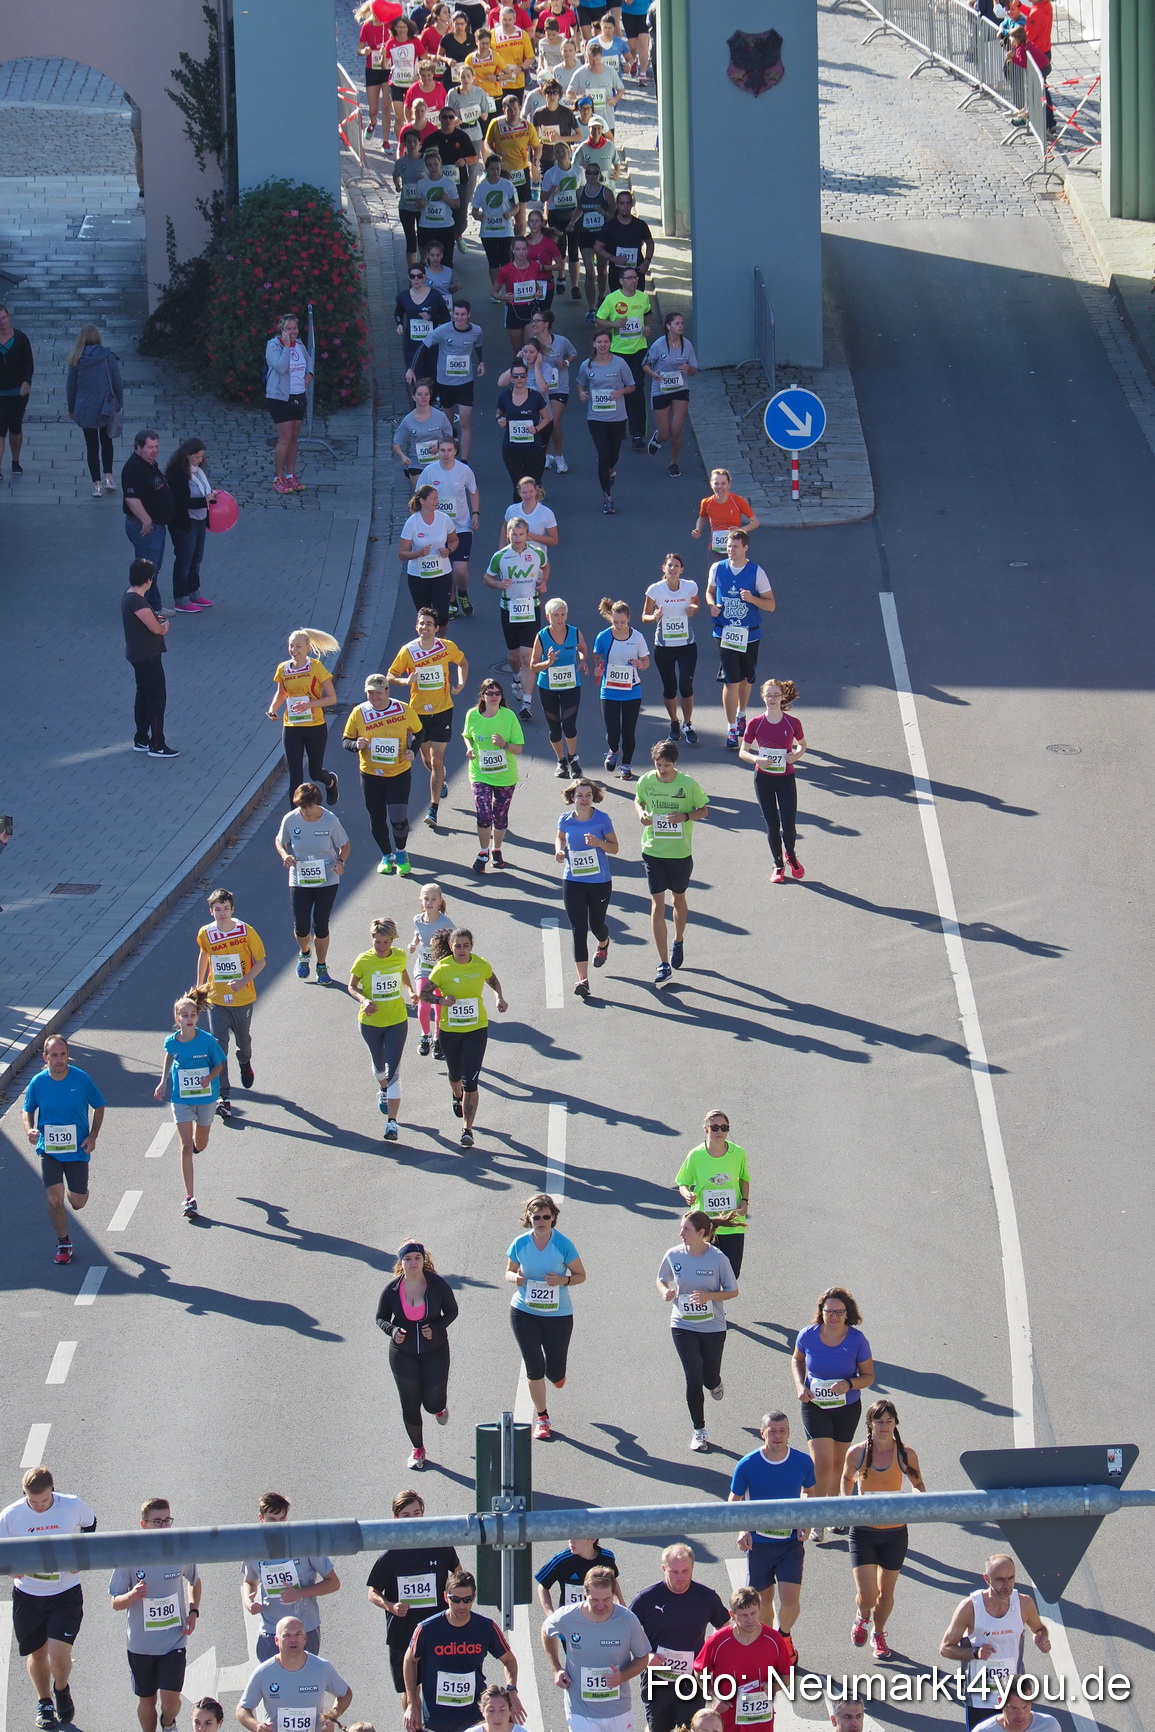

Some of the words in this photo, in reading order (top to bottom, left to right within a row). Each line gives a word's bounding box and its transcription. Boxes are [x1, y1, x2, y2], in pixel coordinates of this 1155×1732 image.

[517, 286, 533, 294] 5110
[413, 324, 430, 332] 5136
[449, 360, 467, 368] 5063
[663, 376, 680, 385] 5007
[422, 560, 439, 570] 5201
[513, 604, 530, 613] 5071
[665, 621, 685, 631] 5054
[725, 632, 744, 642] 5051
[415, 660, 431, 668] MAX
[420, 672, 440, 681] 5213
[553, 672, 572, 681] 5078
[609, 671, 629, 680] 8010
[365, 722, 384, 731] MAX
[386, 715, 406, 725] BÖGL
[375, 745, 395, 754] 5096
[483, 755, 503, 765] 5030
[656, 821, 678, 829] 5216
[573, 856, 594, 866] 5215
[300, 867, 322, 876] 5555
[212, 943, 228, 952] MAX
[229, 938, 247, 947] BÖGL
[216, 962, 237, 972] 5095
[376, 980, 397, 991] 5153
[452, 1005, 474, 1015] 5155
[183, 1077, 204, 1087] 513
[48, 1132, 72, 1142] 5130
[708, 1196, 731, 1208] 5031
[530, 1288, 554, 1300] 5221
[683, 1302, 708, 1312] 5185
[266, 1571, 293, 1585] 5195
[403, 1582, 431, 1595] 5184
[149, 1603, 175, 1617] 5180
[434, 1641, 482, 1656] adidas
[442, 1681, 471, 1693] 5159
[586, 1676, 608, 1688] 515
[742, 1699, 769, 1712] 5125
[283, 1717, 311, 1729] 5158
